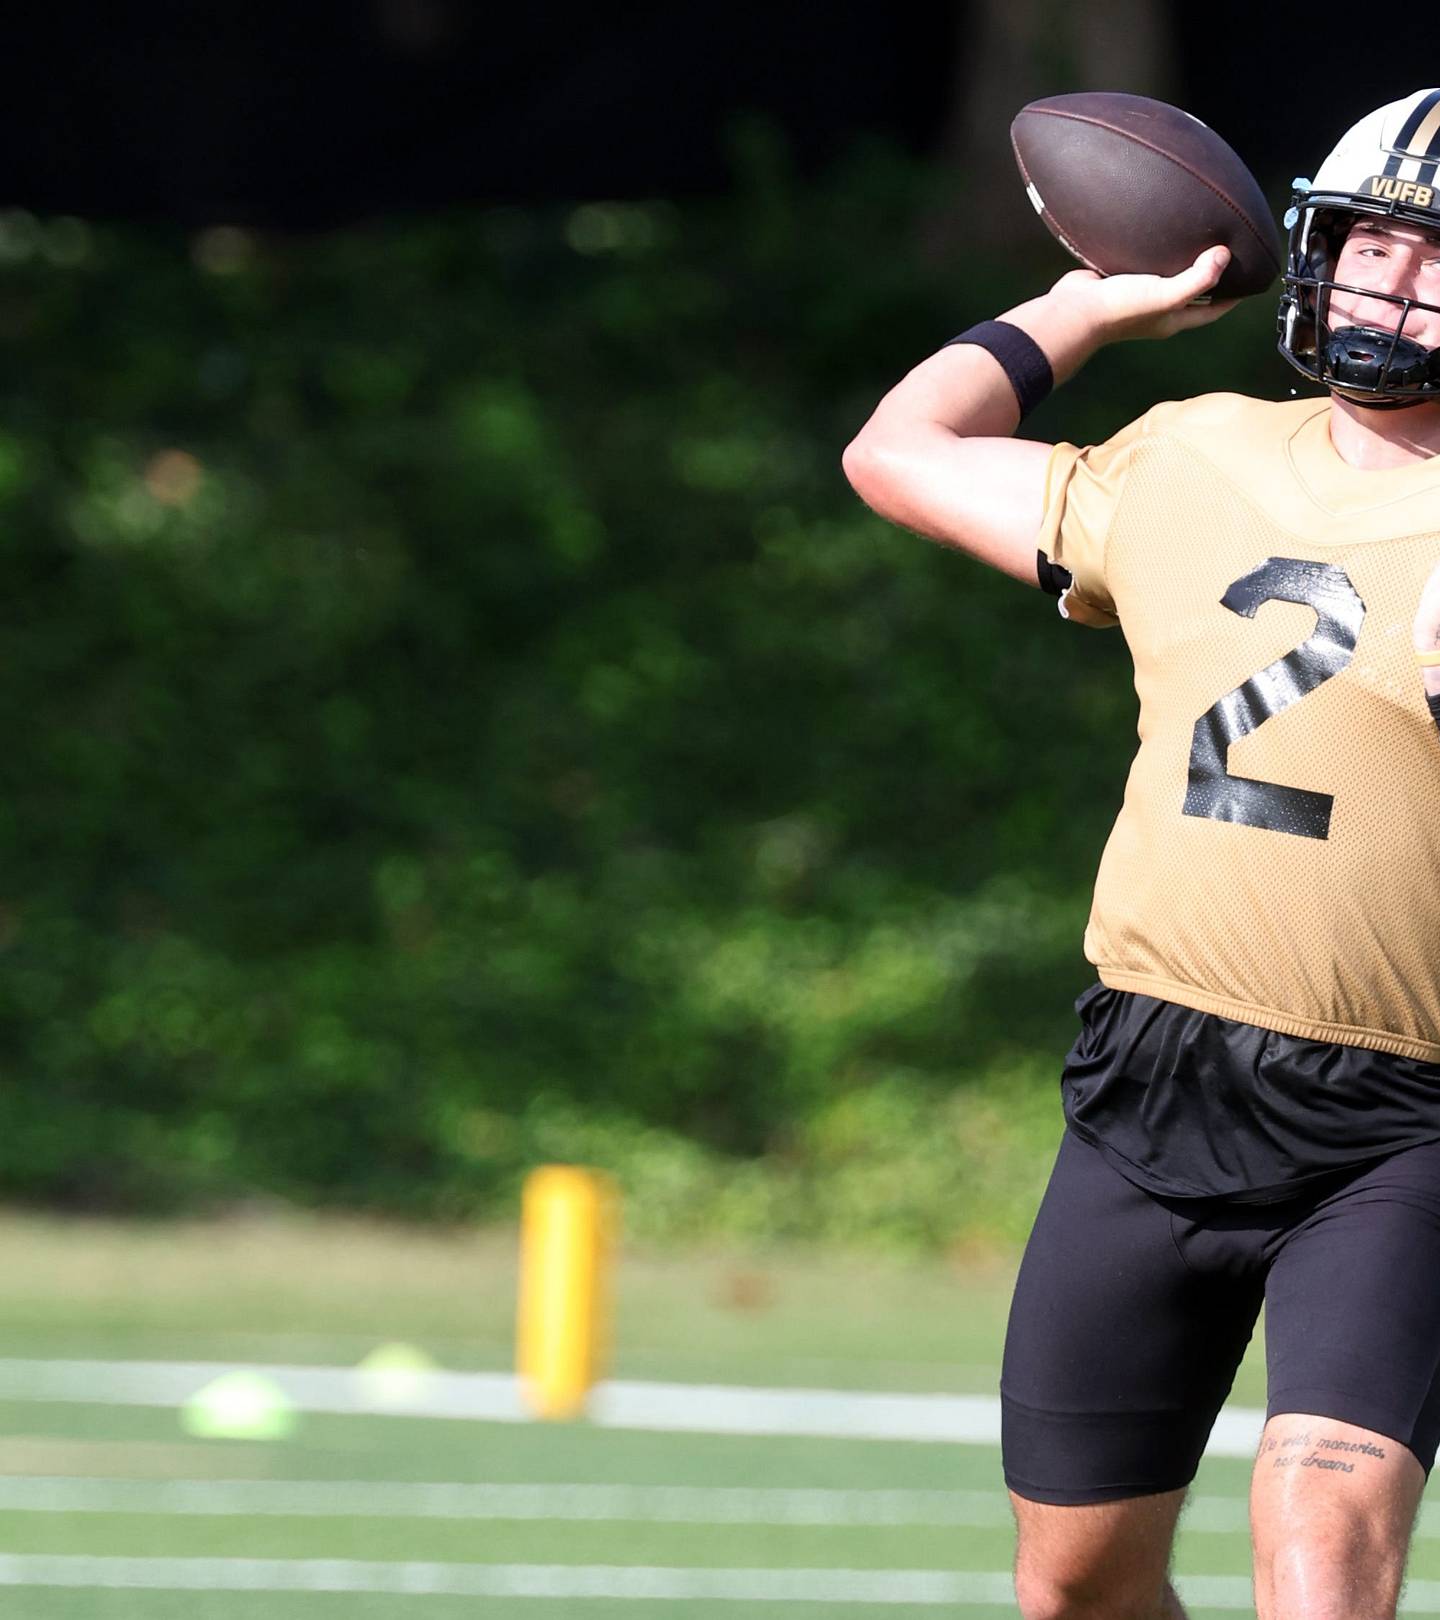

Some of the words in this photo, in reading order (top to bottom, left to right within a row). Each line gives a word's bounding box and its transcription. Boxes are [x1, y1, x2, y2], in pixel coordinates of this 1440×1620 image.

[1371, 177, 1433, 208] VUFB
[1182, 556, 1367, 840] 2
[1300, 1451, 1355, 1473] dreams
